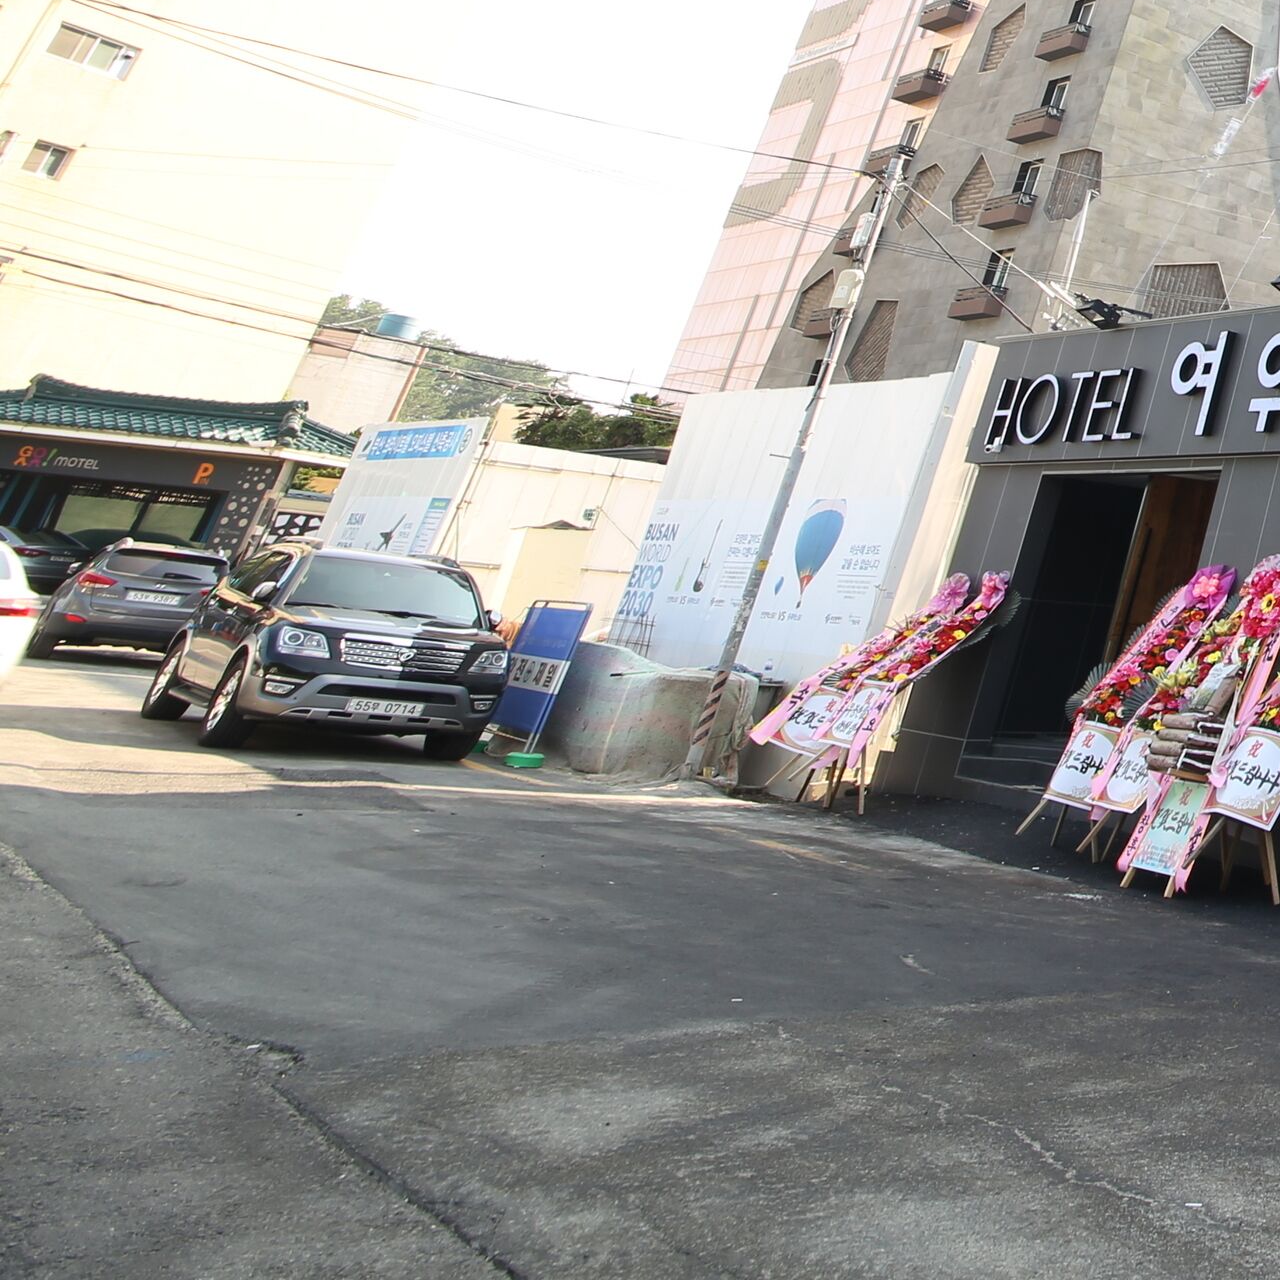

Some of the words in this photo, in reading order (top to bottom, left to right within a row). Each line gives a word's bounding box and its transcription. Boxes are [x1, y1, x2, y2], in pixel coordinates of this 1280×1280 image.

[983, 366, 1140, 447] HOTEL
[645, 523, 680, 541] BUSAN
[639, 544, 672, 562] WORLD
[628, 564, 664, 590] EXPO
[618, 590, 655, 617] 2030
[383, 703, 417, 717] 0714
